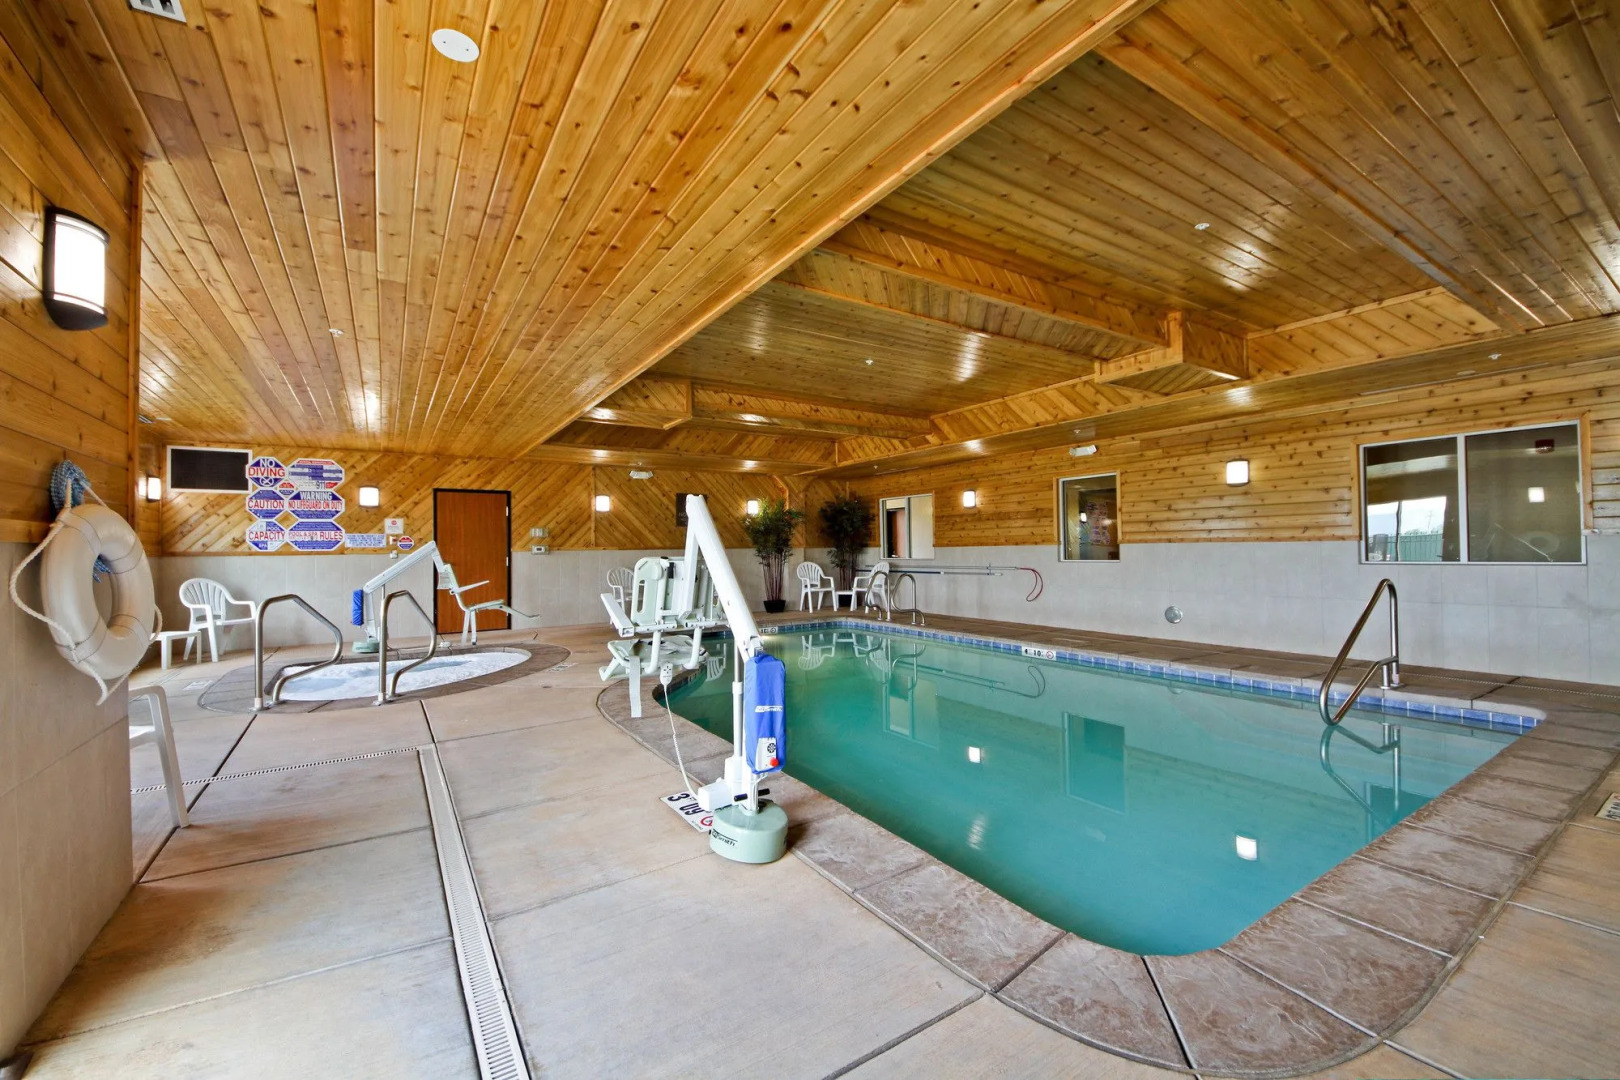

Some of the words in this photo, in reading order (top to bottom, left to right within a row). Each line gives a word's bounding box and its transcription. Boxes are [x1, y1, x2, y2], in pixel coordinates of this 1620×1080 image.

[260, 458, 275, 467] NO
[248, 467, 286, 477] DIVING
[316, 481, 325, 490] 911
[300, 491, 332, 501] WARNING
[247, 499, 285, 509] CAUTION
[288, 500, 296, 509] NO
[296, 500, 322, 510] LIFEGUARD
[322, 500, 330, 510] ON
[331, 501, 342, 511] DUTY
[248, 531, 286, 540] CAPACITY
[319, 531, 343, 540] RULES
